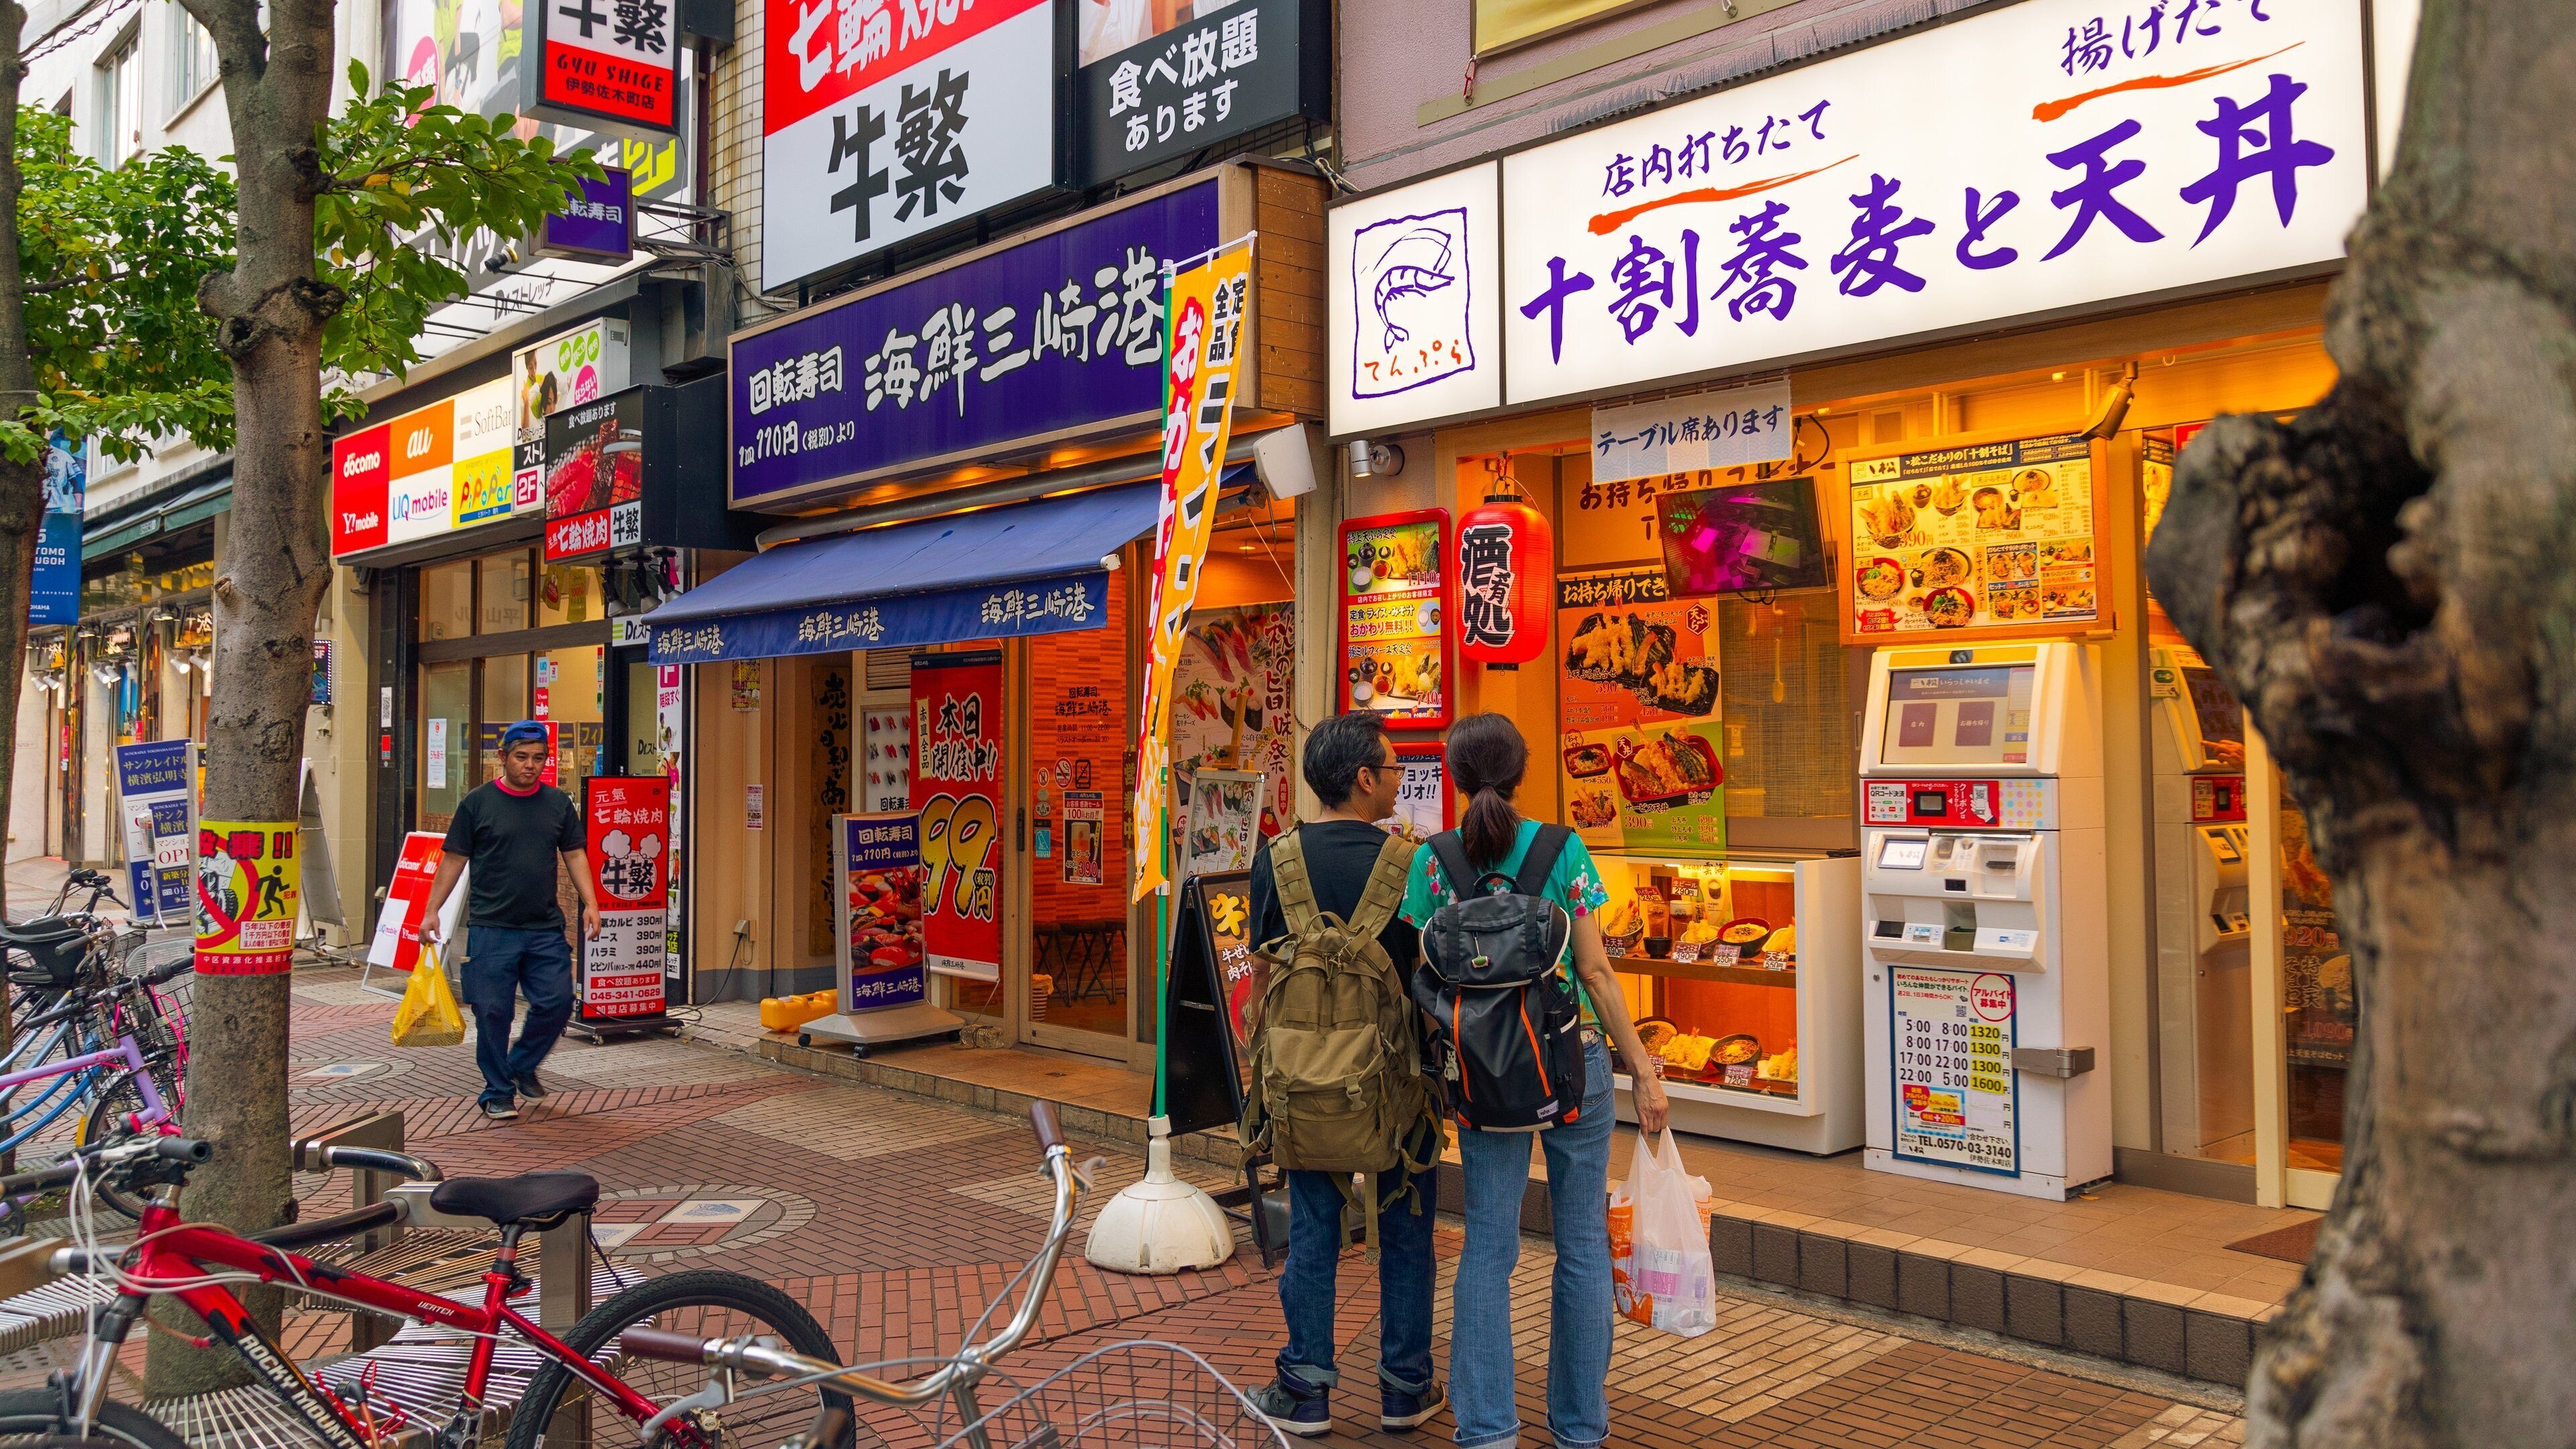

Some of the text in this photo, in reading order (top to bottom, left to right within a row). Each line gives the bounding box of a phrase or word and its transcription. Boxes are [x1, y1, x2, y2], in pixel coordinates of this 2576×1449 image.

[557, 54, 663, 92] GYU SHIGE
[1108, 8, 1258, 118] 食べ放題
[566, 76, 655, 110] 伊勢佐木町店
[1125, 79, 1239, 152] あります
[827, 67, 970, 244] 牛繁
[1603, 99, 1833, 199] 店内打ちたて
[559, 197, 623, 225] 転寿司
[1519, 73, 2335, 366] 十割蕎麦と天丼
[865, 246, 1165, 418] 海鮮三崎港
[1208, 286, 1229, 363] 全品
[1364, 339, 1462, 383] てんぷら
[749, 345, 843, 415] 回転寿司
[568, 401, 616, 429] 食べ放題あります
[407, 426, 433, 459] au
[1596, 404, 1784, 458] テーブル席あります
[343, 451, 381, 478] docomo
[517, 474, 537, 503] 2F
[392, 488, 448, 522] UQ mobile
[343, 511, 379, 534] Y!mobile
[557, 514, 608, 553] 七輪焼肉
[612, 507, 639, 543] 牛繁
[1357, 590, 1433, 604] 店内でお召し上がりのお客様限定
[1460, 523, 1515, 648] 酒処
[1563, 576, 1666, 604] お持ち帰りでき
[981, 581, 1095, 630] 海鮮三崎港
[1349, 604, 1414, 621] 定食 ライス・みそ汁
[798, 606, 886, 649] 海鮮三崎港
[1349, 619, 1413, 637] おかわり無料!!
[657, 623, 725, 661] 海鮮三崎港
[1069, 686, 1098, 699] 回転寿司
[1265, 613, 1296, 775] 秋の旨味祭
[936, 692, 982, 741] 本日
[1055, 698, 1112, 718] 海鮮三崎港
[918, 706, 930, 769] 赤皿全品
[1617, 738, 1631, 756] 天丼
[123, 755, 187, 771] サンクレイドル
[931, 738, 998, 783] 開催中!!
[595, 788, 627, 804] 元氣
[1124, 762, 1136, 840] 営業中
[1397, 784, 1436, 800] リオ!!
[1959, 783, 1968, 820] クーポンは
[594, 807, 663, 825] 七輪焼肉
[1624, 802, 1670, 814] サービス天丼
[1624, 814, 1654, 829] 390円
[858, 824, 913, 845] 回転寿司
[922, 792, 998, 923] 99 円
[602, 859, 654, 895] 牛繁
[1673, 879, 1698, 889] 生ビール
[282, 890, 297, 900] 犯罪
[1674, 887, 1695, 896] 290円
[637, 916, 660, 926] 390円
[636, 930, 660, 941] 390円
[1603, 937, 1623, 947] 上天丼
[590, 945, 660, 957] ハラミ 390円
[1716, 955, 1733, 964] 550円
[1766, 951, 1786, 961] 天丼
[590, 987, 661, 1001] 045-341-0629
[597, 975, 657, 988] 食べ放題あります
[855, 976, 922, 1000] 海鮮三崎港
[1973, 987, 2013, 1000] アルバイト
[596, 1002, 656, 1015] 加盟店募集中
[1980, 998, 2007, 1010] 募集中
[1906, 1018, 1931, 1034] 5:00
[1941, 1022, 1968, 1037] 8:00
[1970, 1025, 2000, 1039] 1320
[1906, 1035, 1931, 1051] 8:00
[1935, 1038, 1968, 1054] 17:00
[1971, 1041, 2001, 1056] 1300
[1900, 1051, 1932, 1067] 17:00
[1935, 1055, 1968, 1071] 22:00
[1972, 1059, 2002, 1074] 1300
[1900, 1067, 2002, 1092] 22:00 5:00 1600
[1917, 1135, 2012, 1159] TEL.0570-03-3140
[417, 1301, 455, 1317] VERTEX
[237, 1333, 300, 1395] ROCKY
